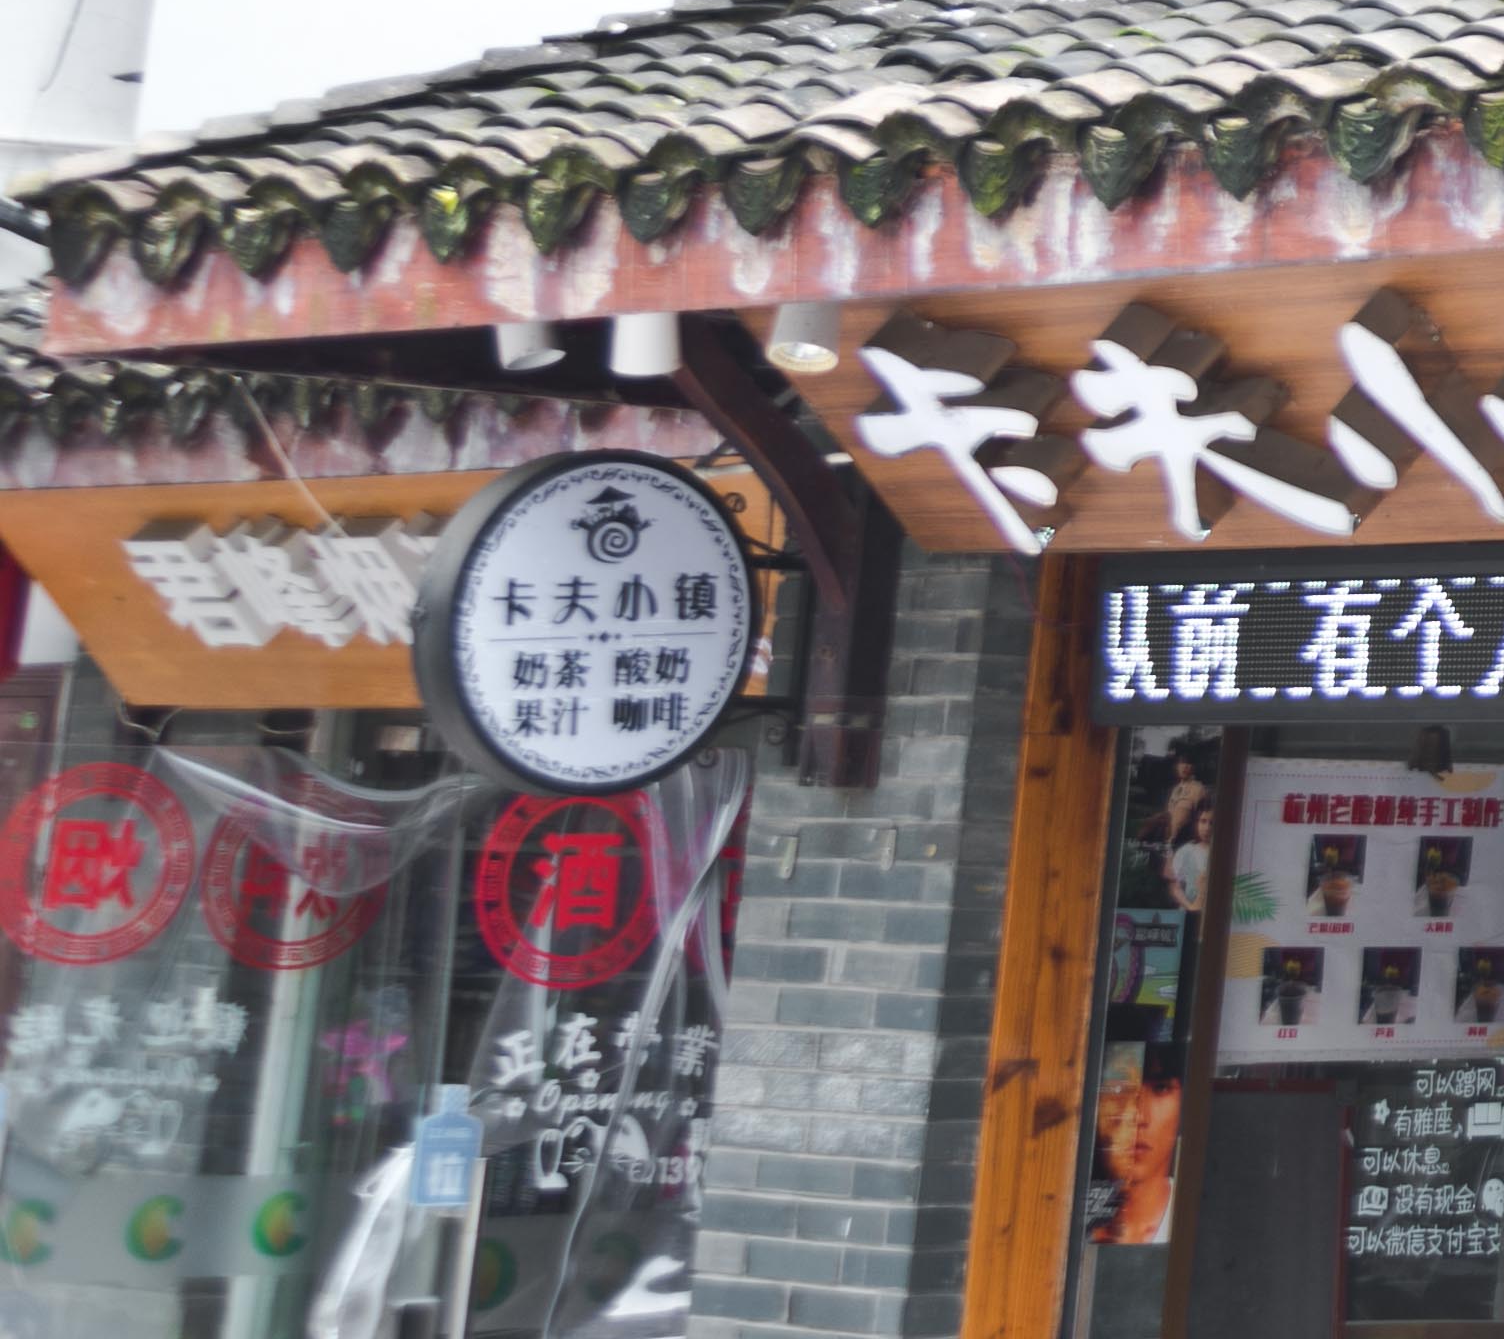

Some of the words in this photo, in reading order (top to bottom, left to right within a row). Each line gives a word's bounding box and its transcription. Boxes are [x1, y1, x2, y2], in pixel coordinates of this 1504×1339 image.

[489, 573, 719, 625] 卡夫小镇
[513, 650, 592, 689] 奶茶
[613, 646, 692, 686] 酸奶
[512, 696, 588, 737] 果汁
[612, 692, 689, 732] 咖啡
[529, 833, 624, 932] 酒
